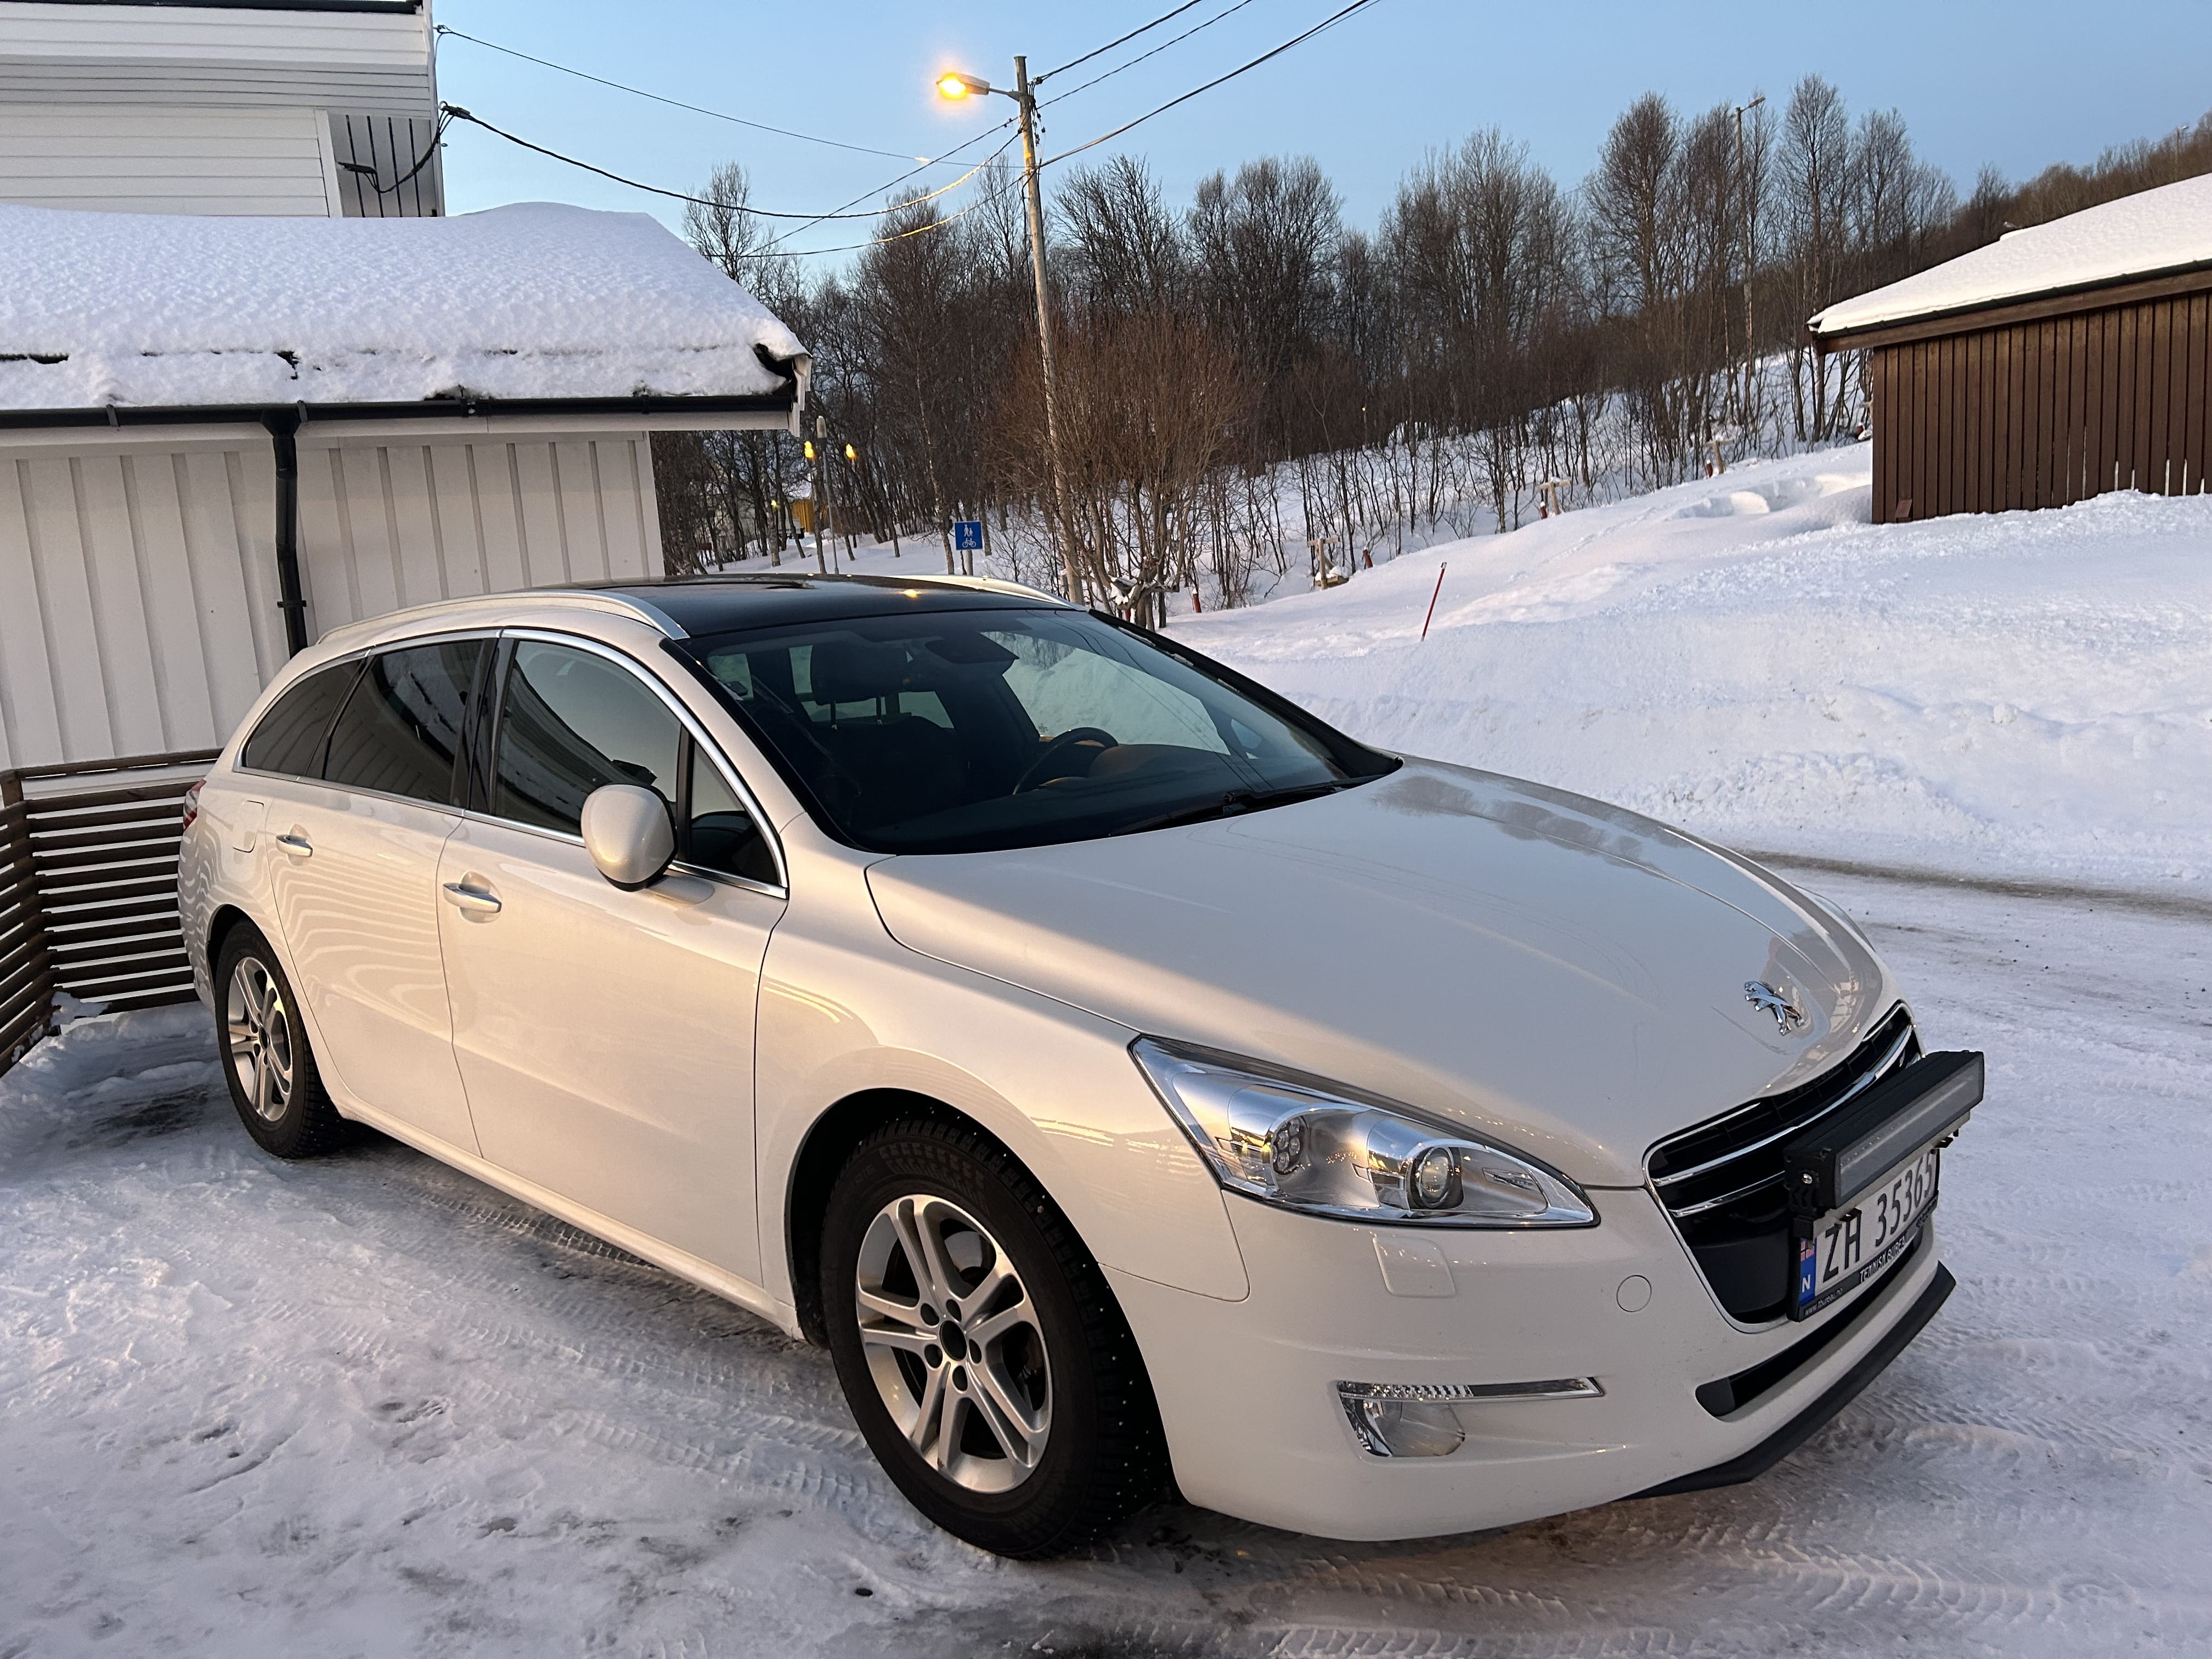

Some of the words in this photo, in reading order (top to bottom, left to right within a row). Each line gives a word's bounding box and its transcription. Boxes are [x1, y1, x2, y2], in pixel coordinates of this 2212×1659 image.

[1823, 1210, 1861, 1283] ZH
[1875, 1152, 1932, 1247] 35365
[1802, 1274, 1810, 1293] N
